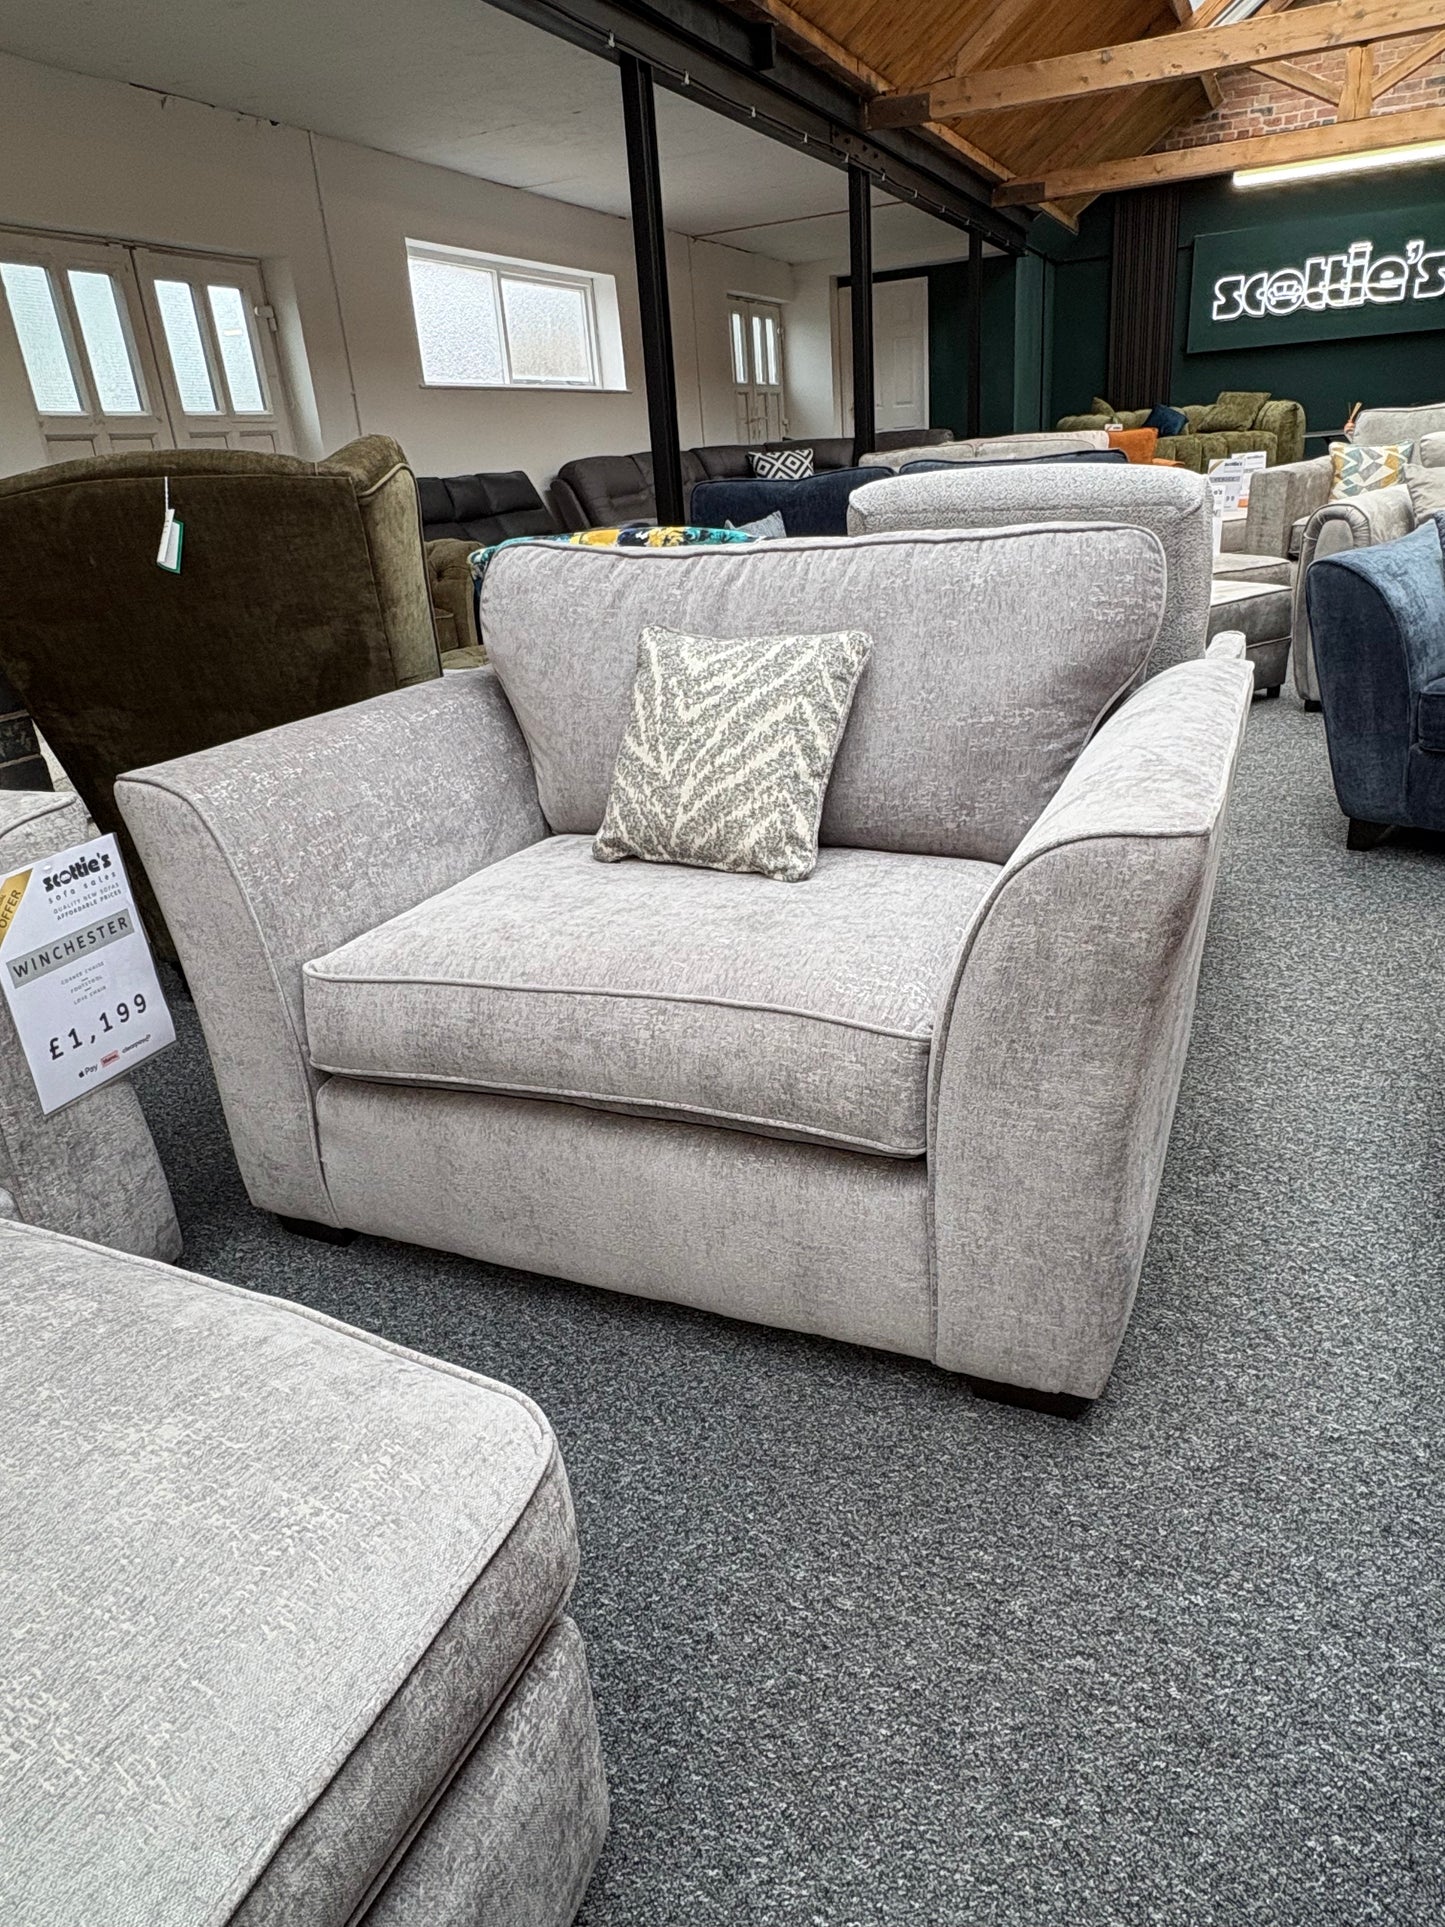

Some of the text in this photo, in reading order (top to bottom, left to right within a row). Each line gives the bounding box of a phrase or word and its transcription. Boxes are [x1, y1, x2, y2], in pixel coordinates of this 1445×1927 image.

[1212, 239, 1445, 321] scottie's
[43, 852, 112, 893] scottie's
[48, 871, 116, 905] sofa sales
[0, 890, 21, 928] OFFER
[53, 882, 119, 914] QUALITY NEW SOFAS
[57, 889, 122, 921] AFFORDABLE PRICES
[12, 916, 129, 978] WINCHESTER
[49, 993, 148, 1060] £1,199
